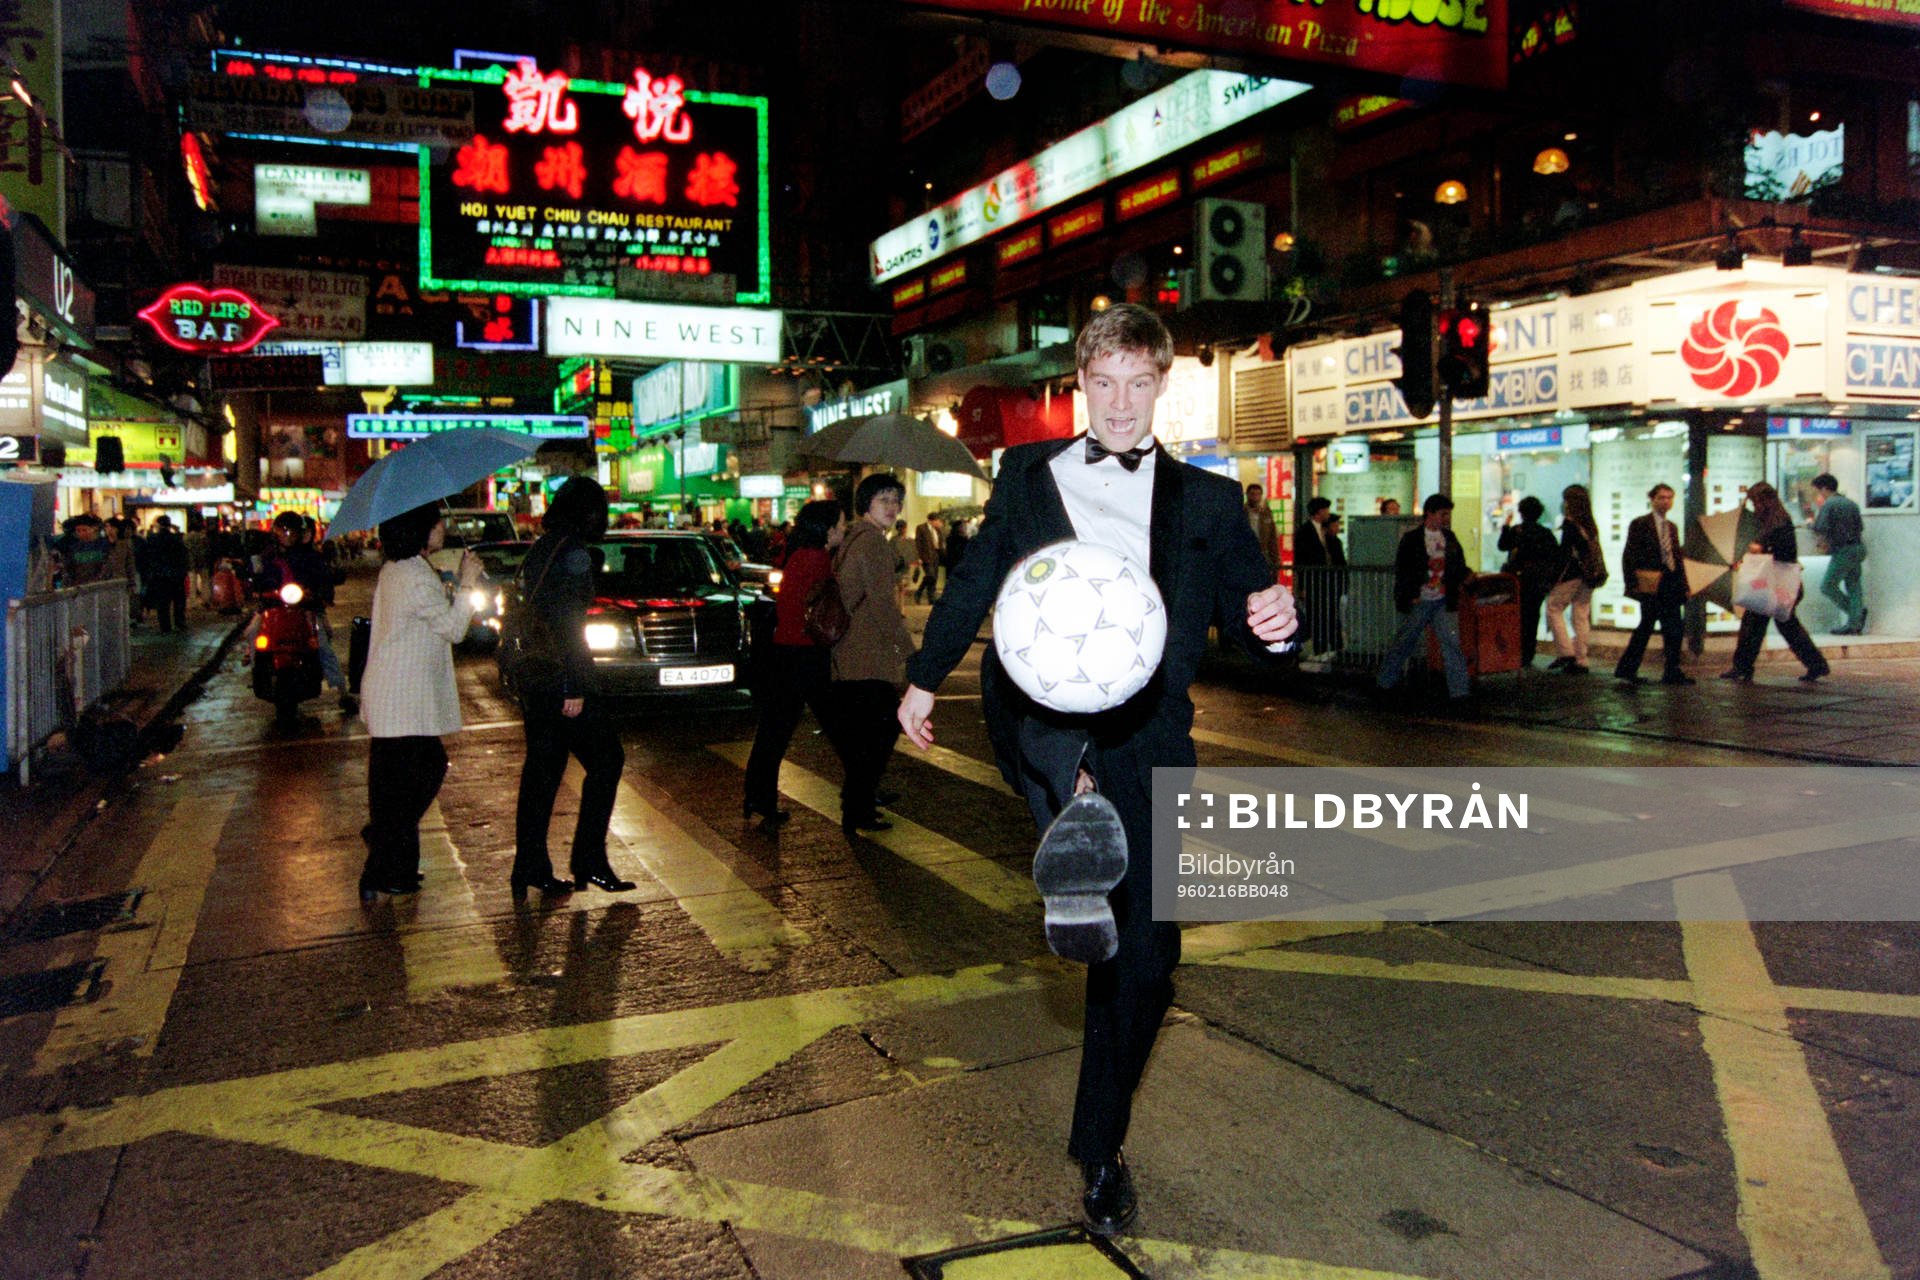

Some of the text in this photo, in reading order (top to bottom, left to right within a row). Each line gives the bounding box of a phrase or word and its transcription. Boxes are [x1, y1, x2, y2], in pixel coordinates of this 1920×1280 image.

[1102, 0, 1124, 24] of
[1139, 0, 1172, 25] the
[1176, 4, 1292, 45] American
[461, 203, 733, 231] HOI YUET CHIU CHAU RESTAURANT
[886, 243, 923, 272] QANTAS
[169, 298, 203, 317] RED
[209, 301, 251, 319] LIPS
[175, 318, 243, 342] BAR
[564, 316, 764, 347] NINE WEST
[812, 390, 892, 434] NINE WEST
[1510, 428, 1548, 445] CHANGE
[664, 668, 730, 683] EA 4070
